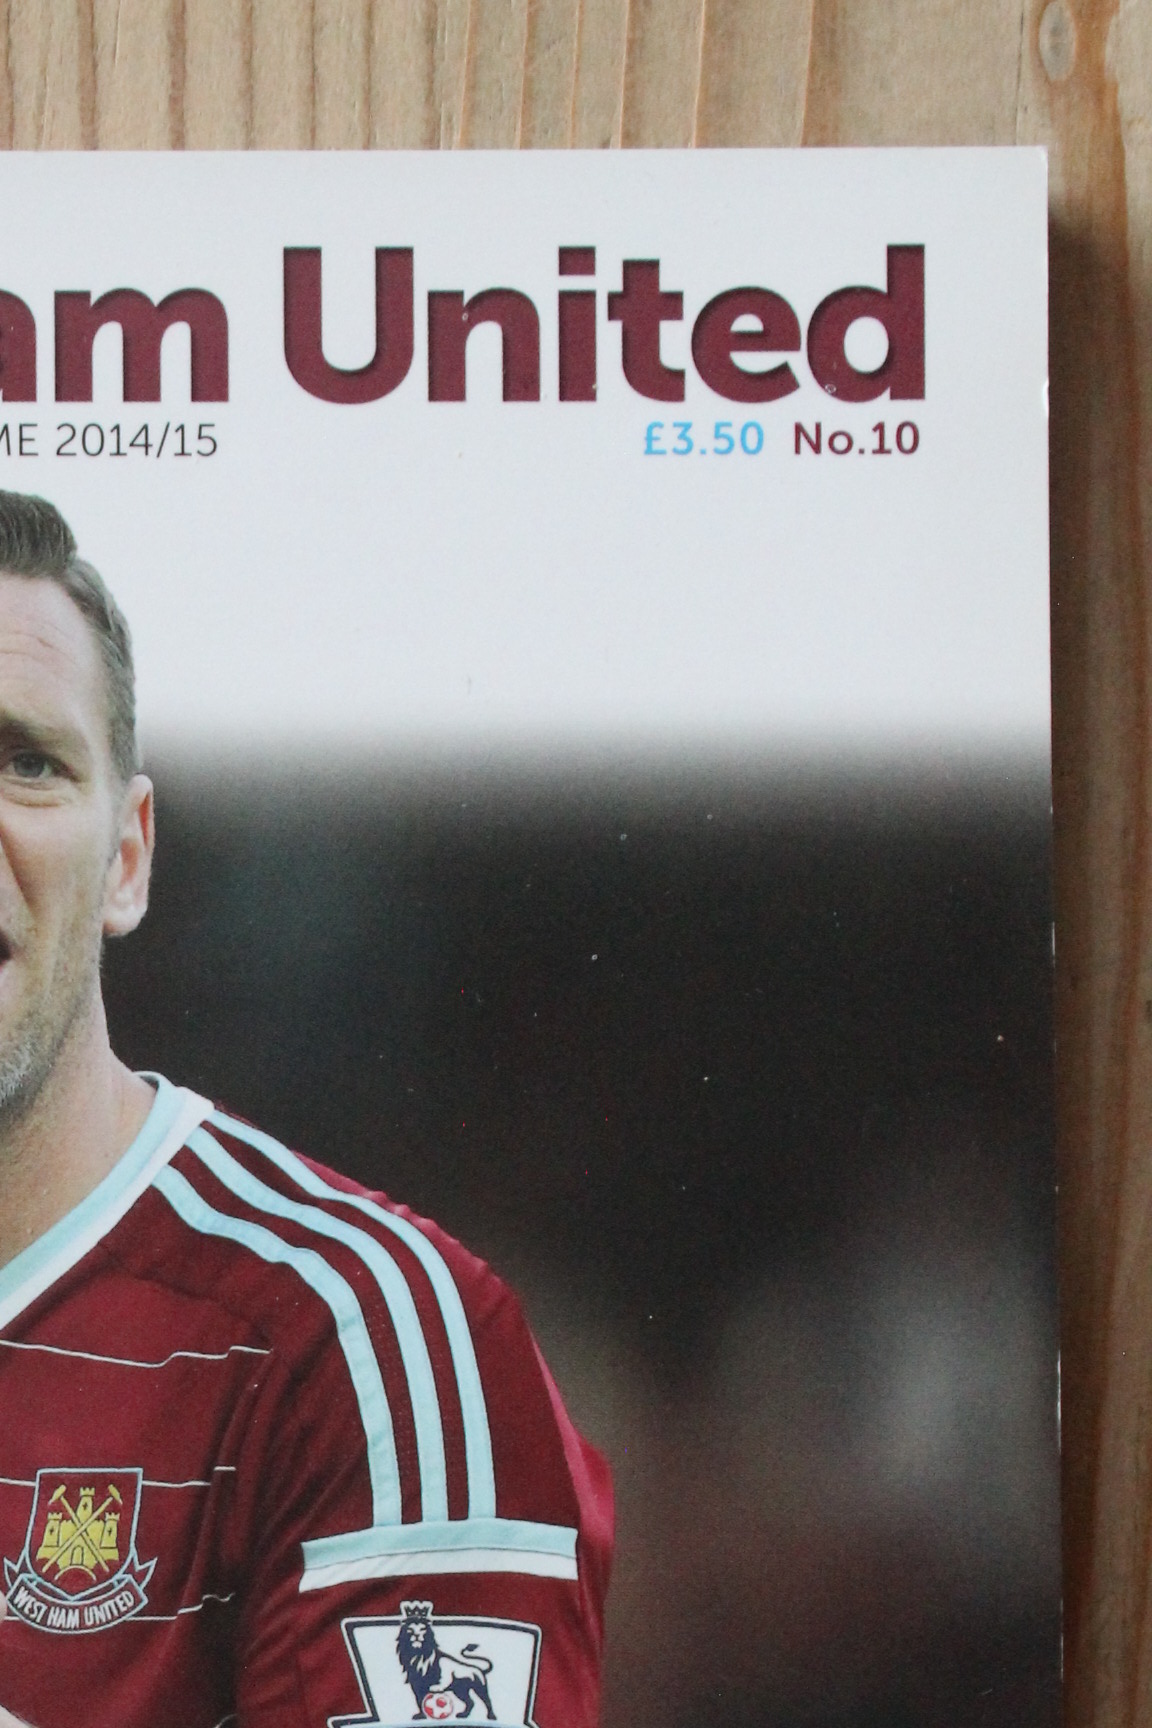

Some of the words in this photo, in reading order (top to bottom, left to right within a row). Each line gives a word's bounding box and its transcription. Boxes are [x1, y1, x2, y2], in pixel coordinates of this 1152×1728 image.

[283, 244, 925, 404] United
[56, 421, 218, 459] 2014/15
[644, 420, 764, 456] £3.50
[793, 421, 920, 455] No.10
[13, 1586, 47, 1622] WEST
[48, 1607, 79, 1629] HAM
[84, 1591, 135, 1625] UNITED
